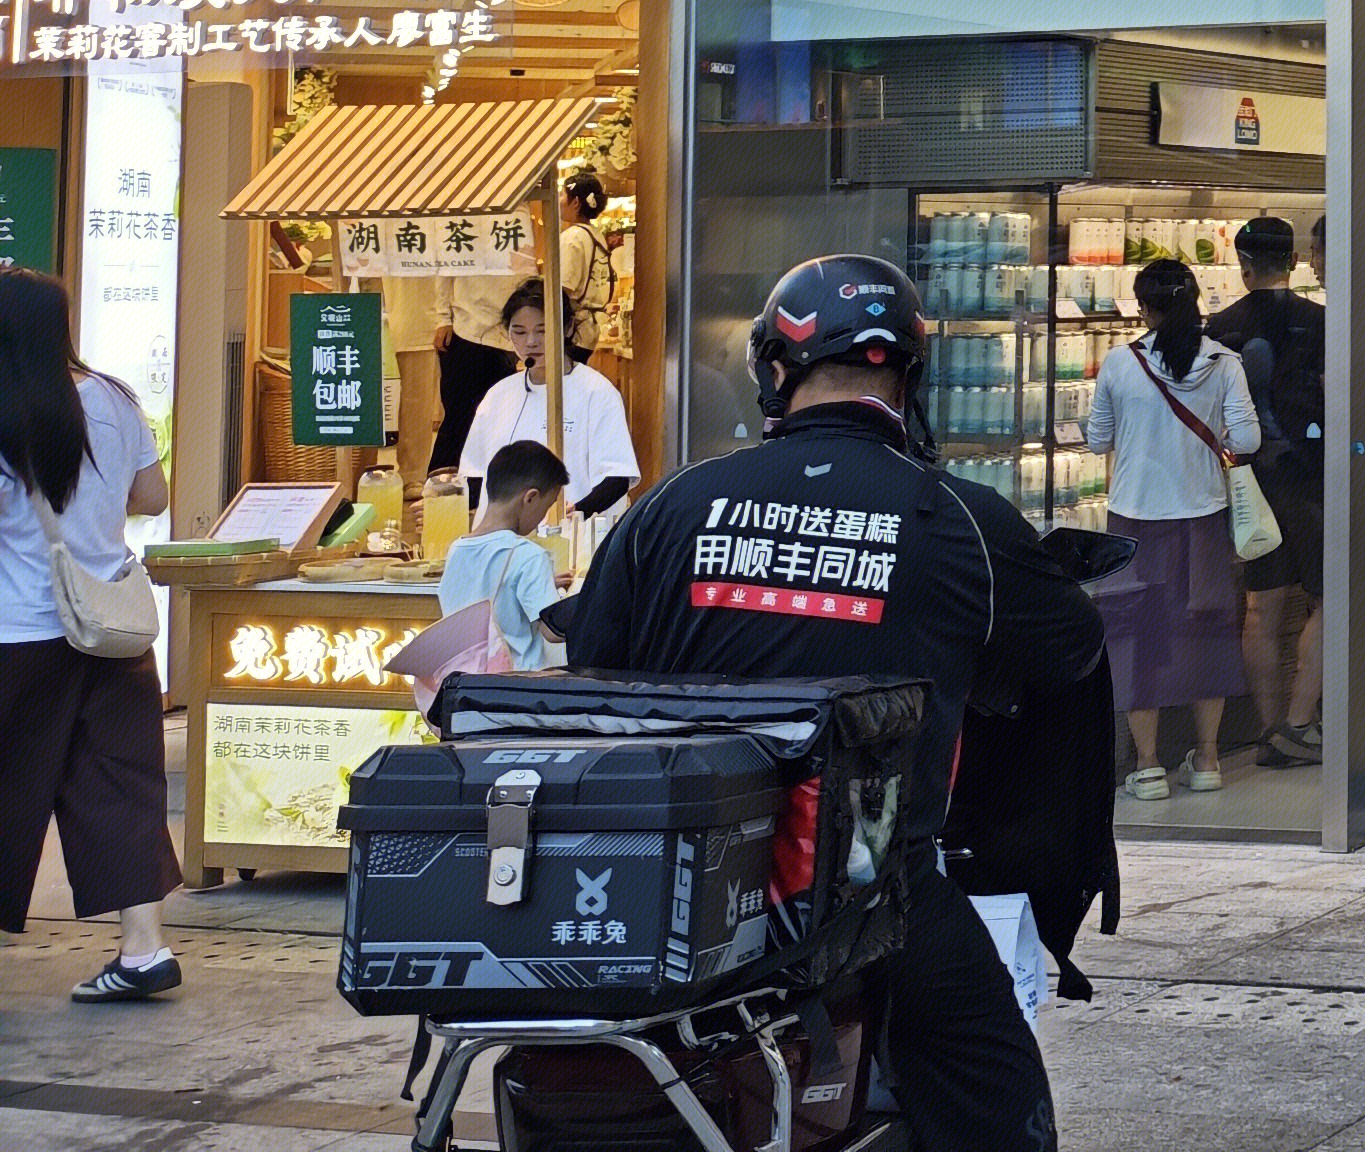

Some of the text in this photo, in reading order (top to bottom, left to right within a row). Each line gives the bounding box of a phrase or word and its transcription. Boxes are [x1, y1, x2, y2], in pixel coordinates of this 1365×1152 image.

[118, 168, 151, 198] 湖南
[89, 208, 177, 241] 茉莉花茶香
[346, 217, 526, 255] 湖南茶饼
[451, 259, 475, 267] CAKE
[311, 345, 361, 376] 顺丰
[312, 379, 362, 411] 包邮
[705, 497, 902, 545] 1小时送蛋糕
[694, 535, 897, 592] 用顺丰同城
[704, 586, 868, 617] 专业高端急送
[213, 715, 352, 738] 湖南茉莉花茶香
[213, 741, 331, 763] 都在这块饼里
[551, 919, 628, 946] 乖乖兔
[597, 964, 653, 975] RACING
